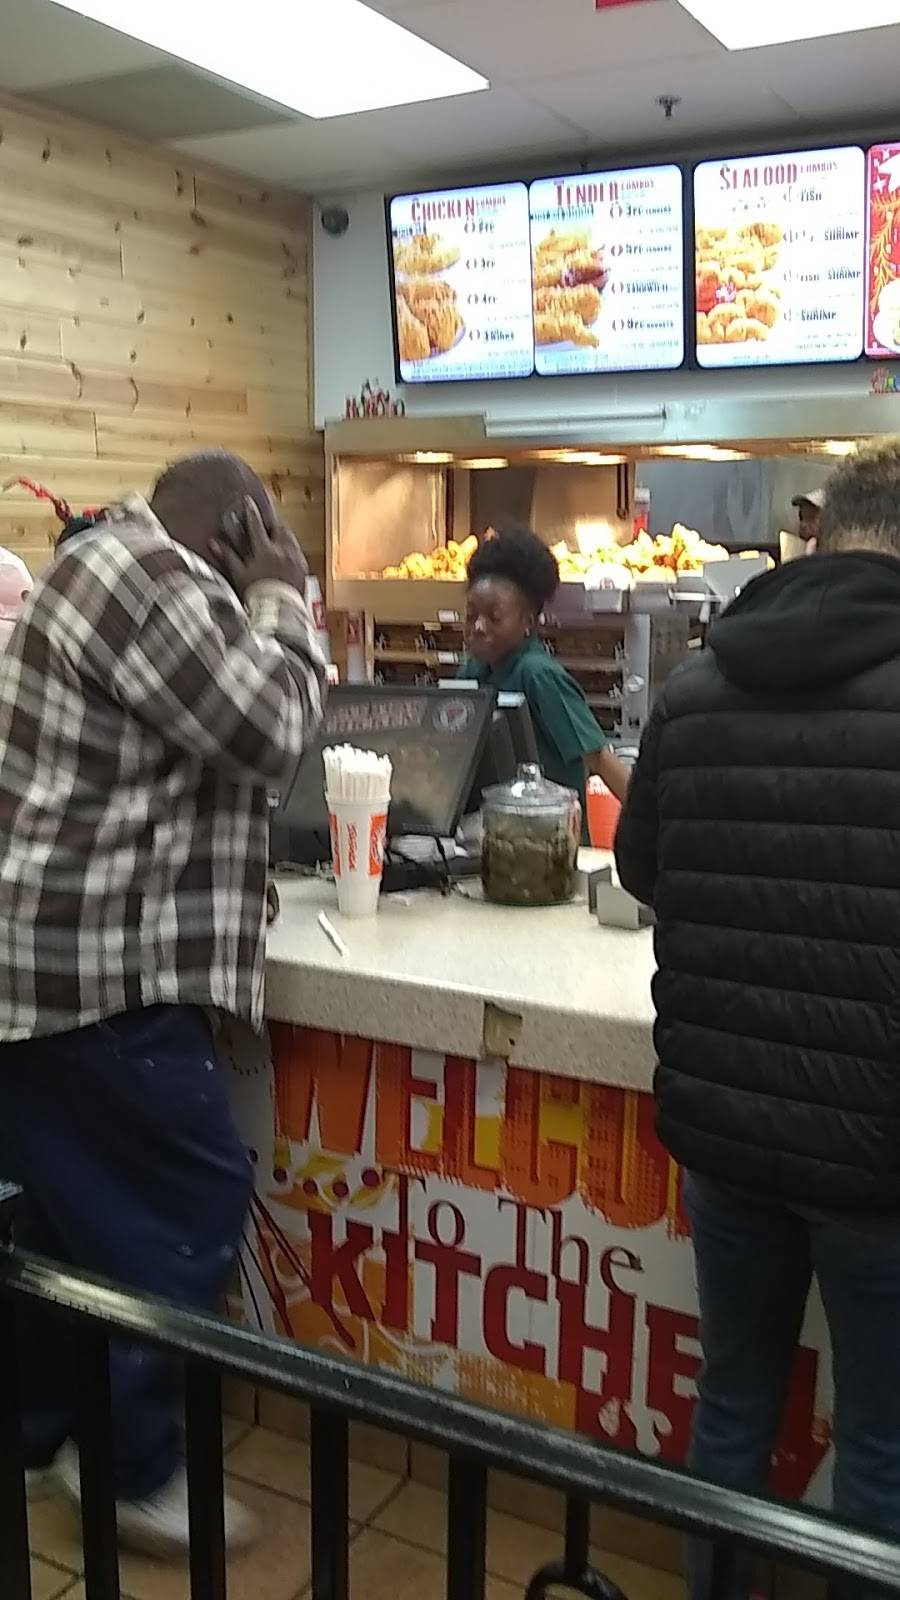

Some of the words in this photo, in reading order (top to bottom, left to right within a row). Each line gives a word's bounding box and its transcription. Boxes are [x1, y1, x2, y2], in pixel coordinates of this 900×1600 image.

[719, 162, 798, 191] SEAFOOD
[411, 196, 476, 222] CHICKEN
[553, 180, 619, 209] TENDER
[271, 1024, 692, 1240] WELCO
[307, 1208, 706, 1408] KITCHE
